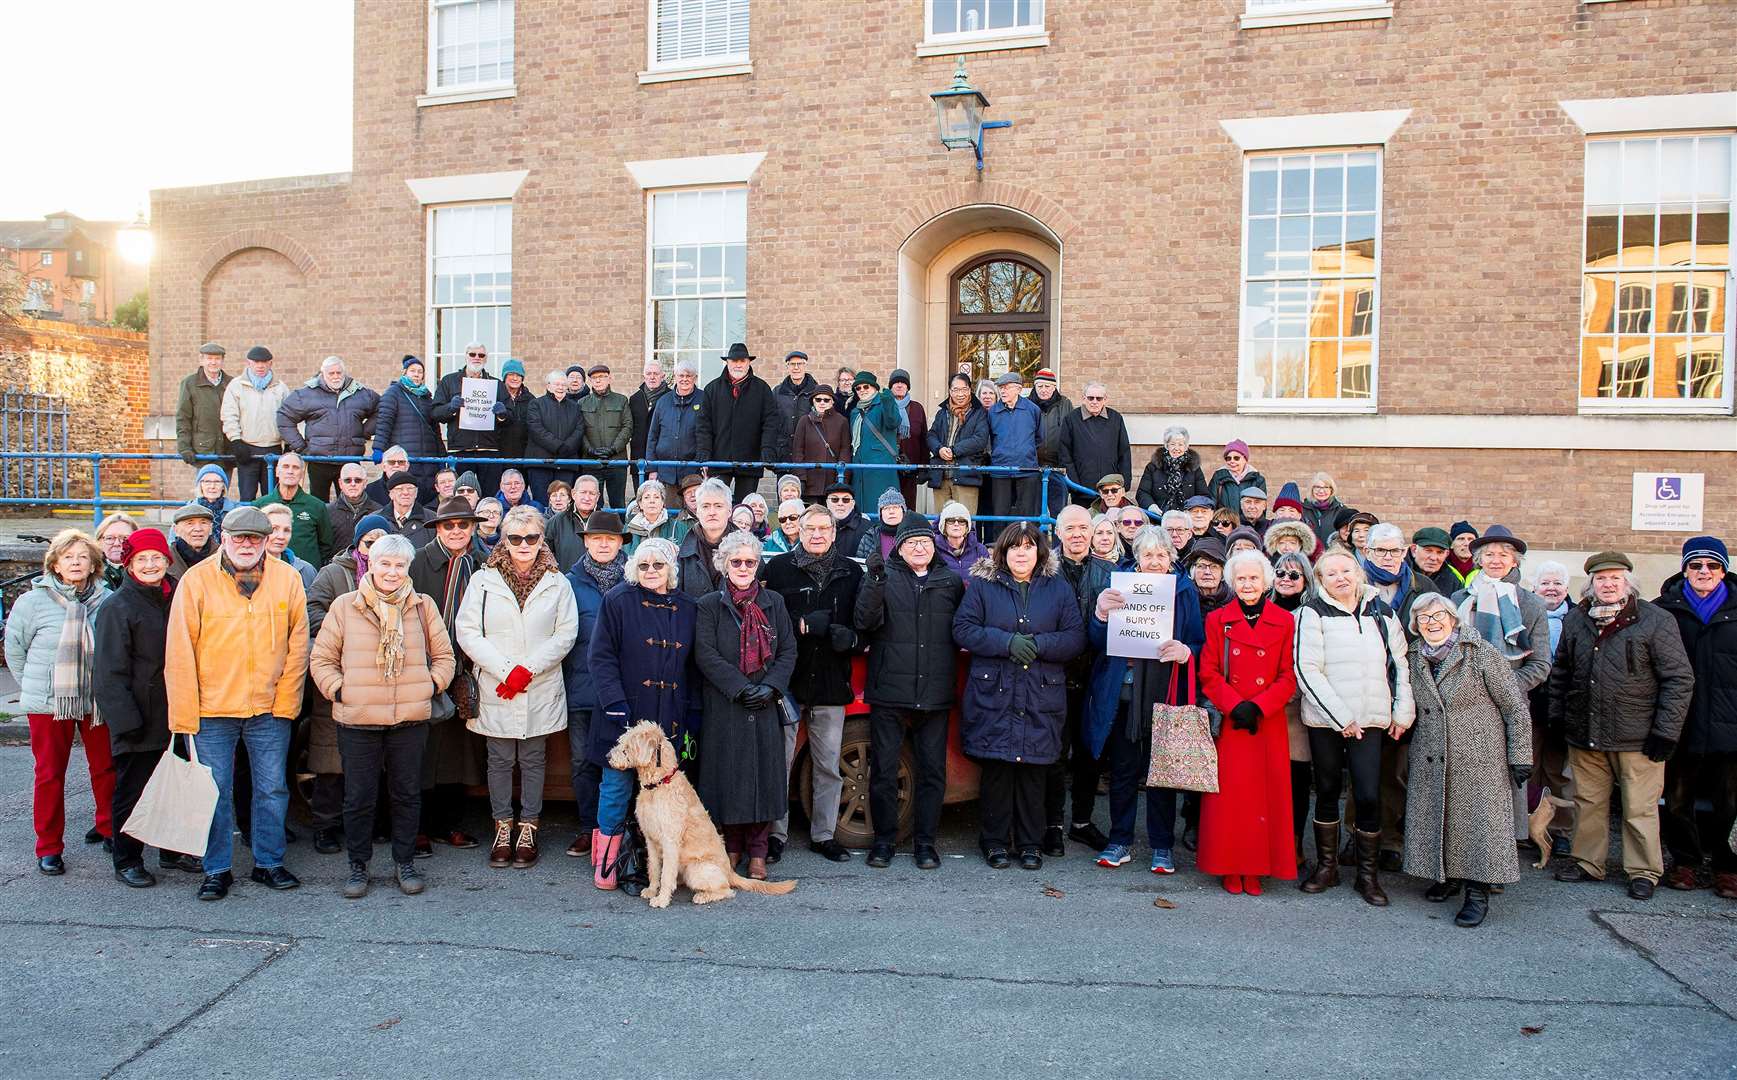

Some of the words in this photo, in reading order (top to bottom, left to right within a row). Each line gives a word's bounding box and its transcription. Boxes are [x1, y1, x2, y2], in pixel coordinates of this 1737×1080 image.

[1133, 584, 1153, 593] SCC
[1126, 616, 1156, 625] BURY'S
[1119, 629, 1160, 639] ARCHIVES
